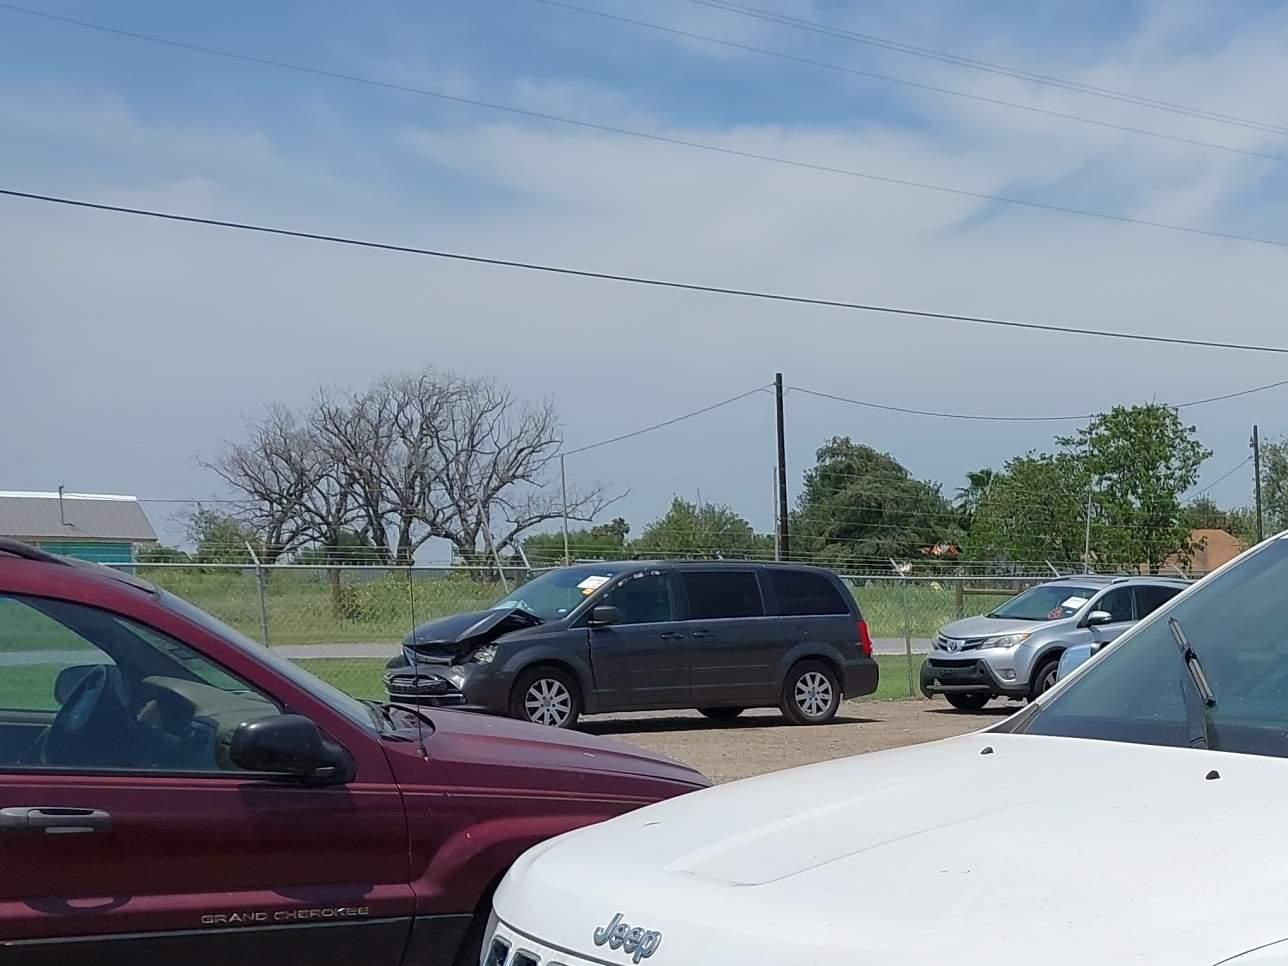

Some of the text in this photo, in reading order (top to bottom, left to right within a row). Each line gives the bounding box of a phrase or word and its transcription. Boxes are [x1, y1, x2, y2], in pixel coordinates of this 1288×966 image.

[200, 906, 369, 924] GRAND CHEROKEE
[593, 912, 662, 964] Jeep
